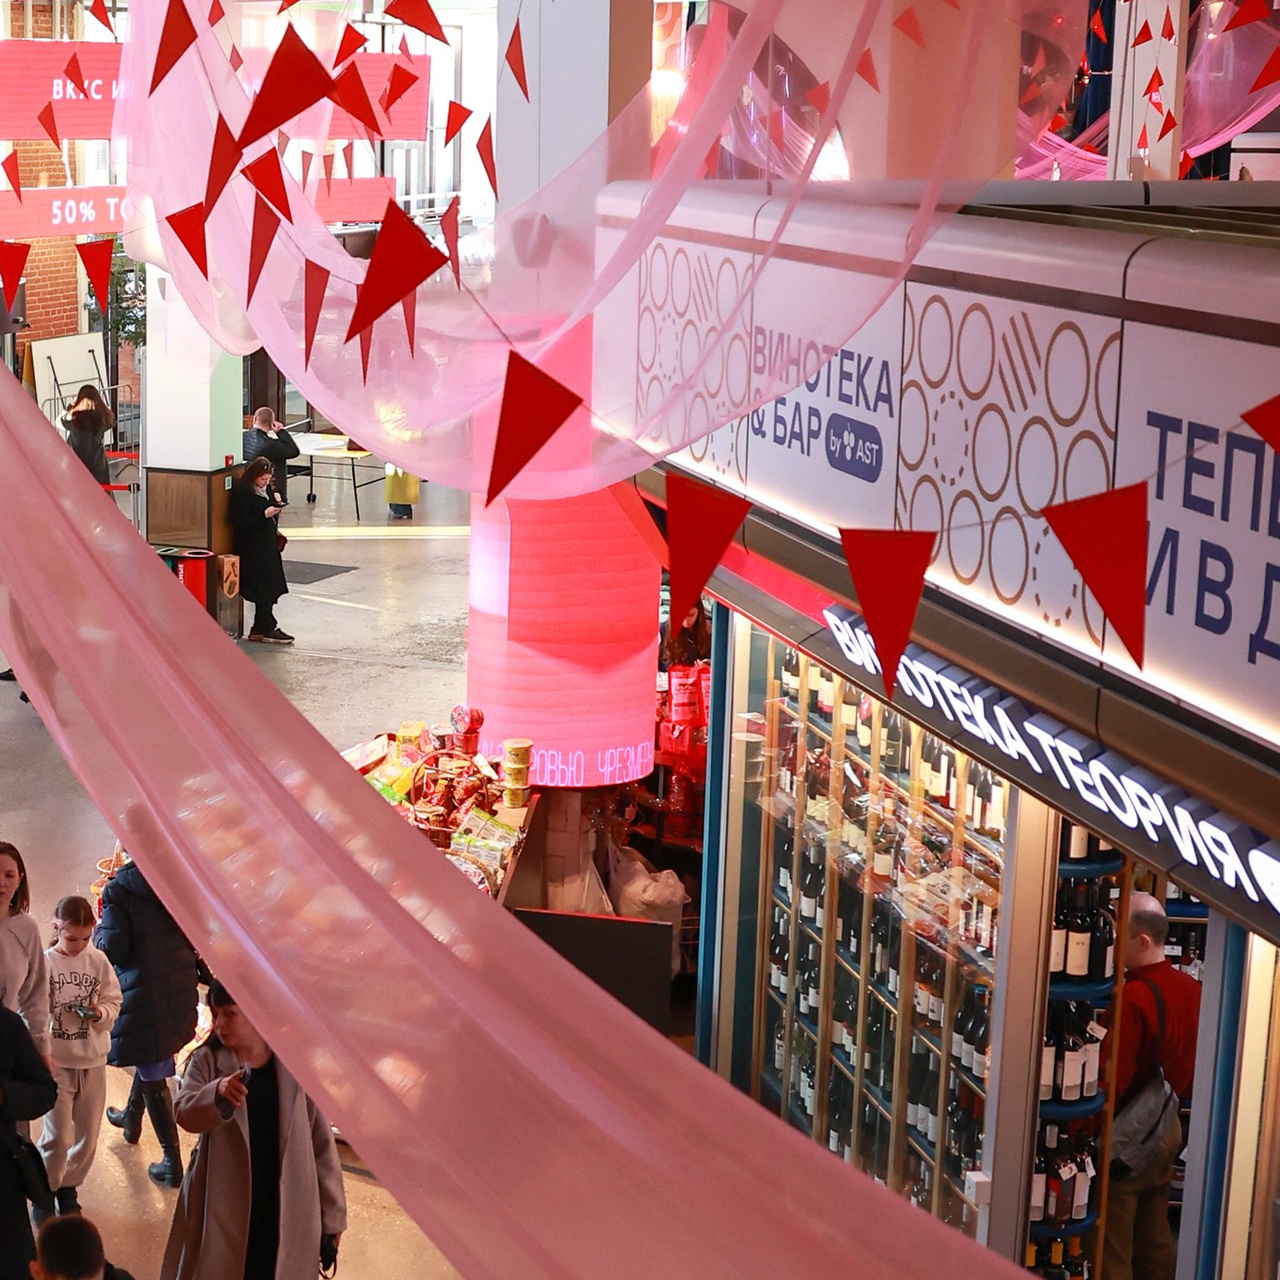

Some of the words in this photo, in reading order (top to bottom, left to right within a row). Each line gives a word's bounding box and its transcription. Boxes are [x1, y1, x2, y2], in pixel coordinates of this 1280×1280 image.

[51, 198, 96, 224] 50%
[752, 324, 895, 419] ВИНОТЕКА
[773, 395, 823, 458] БАР
[829, 428, 843, 459] by
[856, 438, 880, 467] AST
[822, 608, 1043, 775] ВИОТЕКА
[1023, 720, 1260, 903] ТЕОРИЯ
